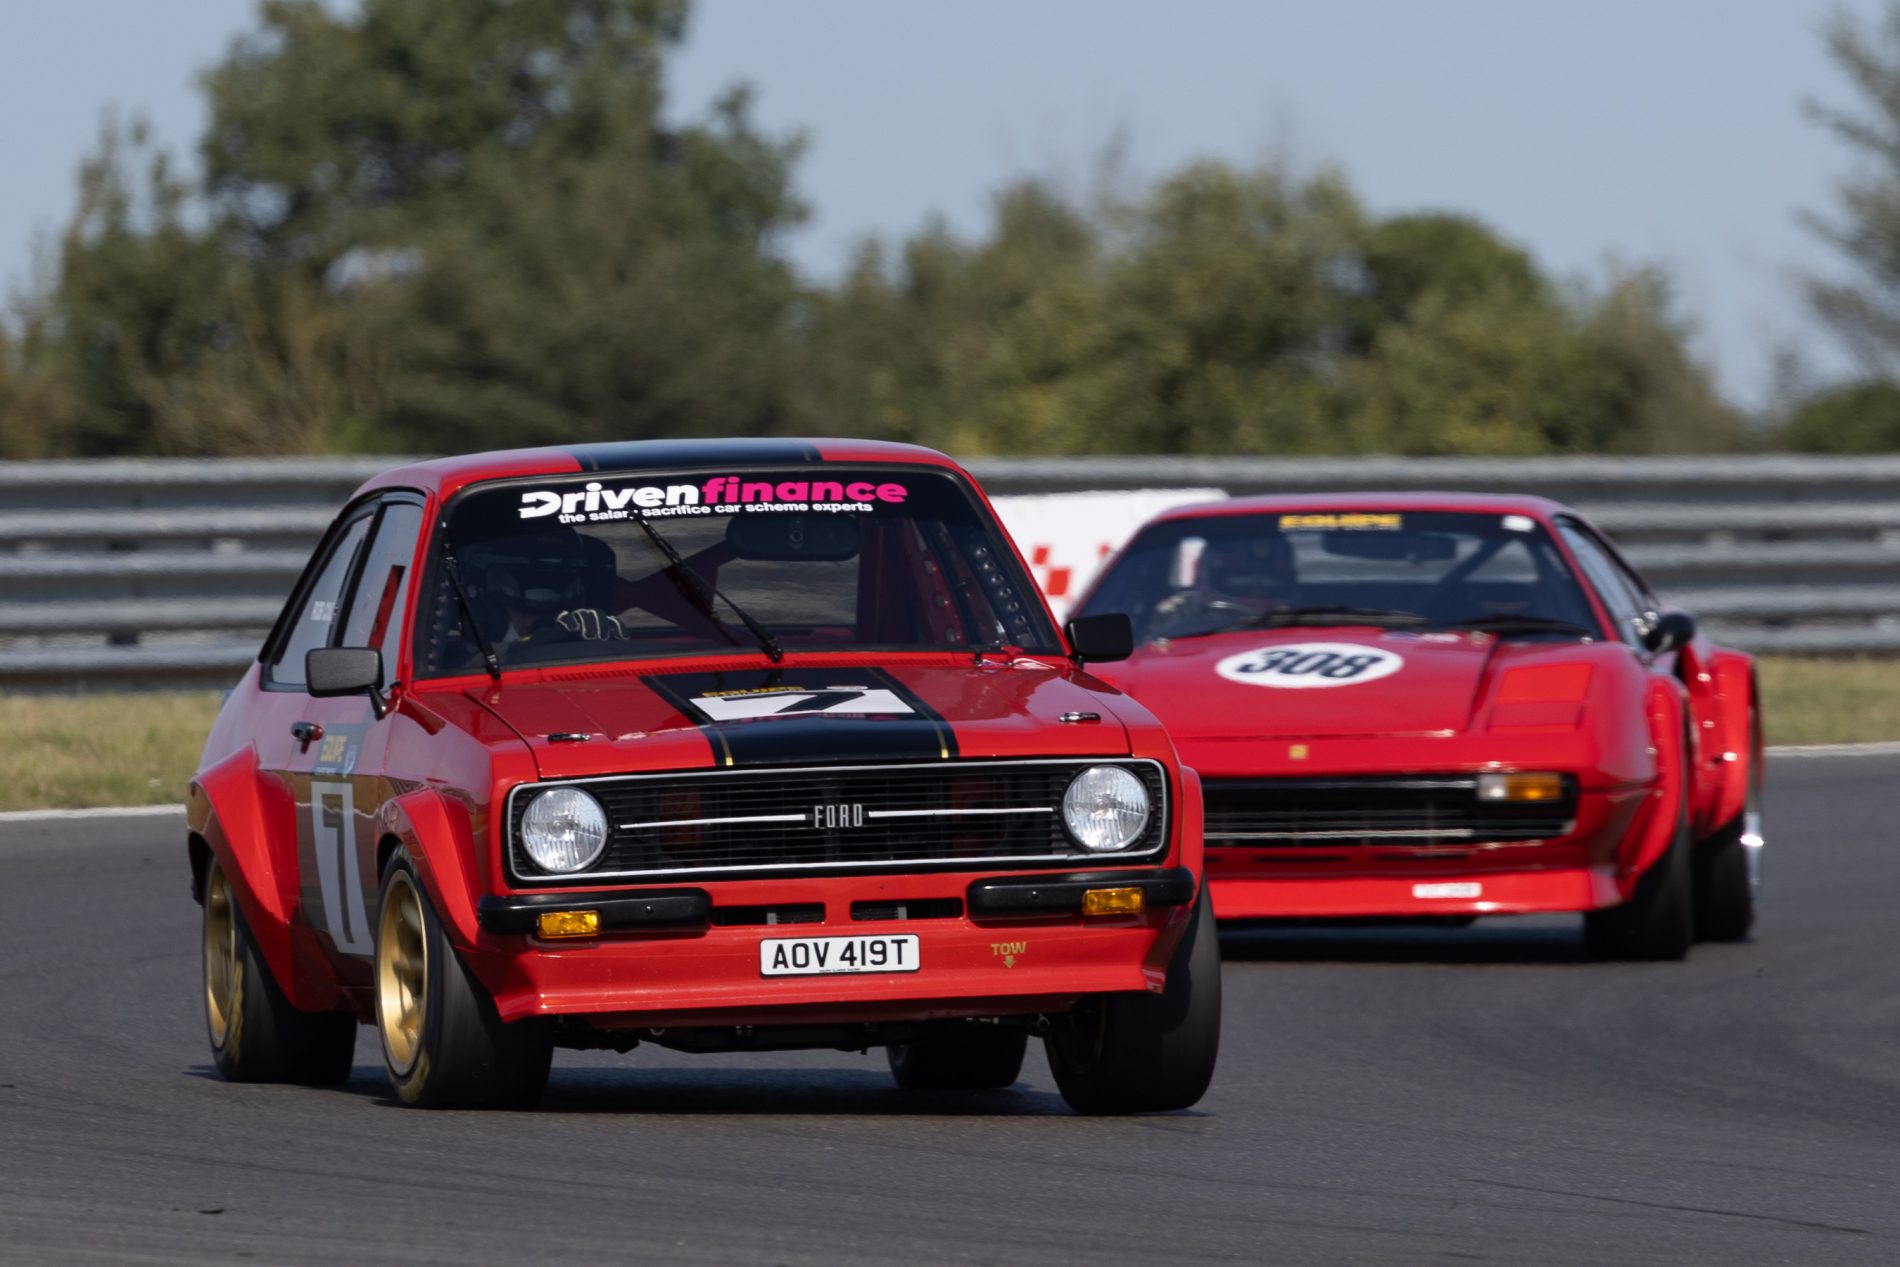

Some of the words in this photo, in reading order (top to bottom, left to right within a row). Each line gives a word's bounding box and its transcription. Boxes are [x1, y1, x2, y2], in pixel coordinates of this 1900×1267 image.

[518, 482, 699, 518] Driven
[702, 476, 908, 503] finance
[558, 513, 586, 524] the
[589, 510, 637, 522] salar
[641, 504, 711, 517] sacrifice
[715, 504, 741, 514] car
[745, 502, 809, 513] scheme
[812, 501, 874, 513] experts
[1236, 649, 1385, 678] 308
[720, 691, 867, 715] 7
[814, 803, 863, 829] FORD
[772, 942, 830, 969] AOV
[839, 939, 909, 967] 419T
[990, 941, 1027, 956] TOW
